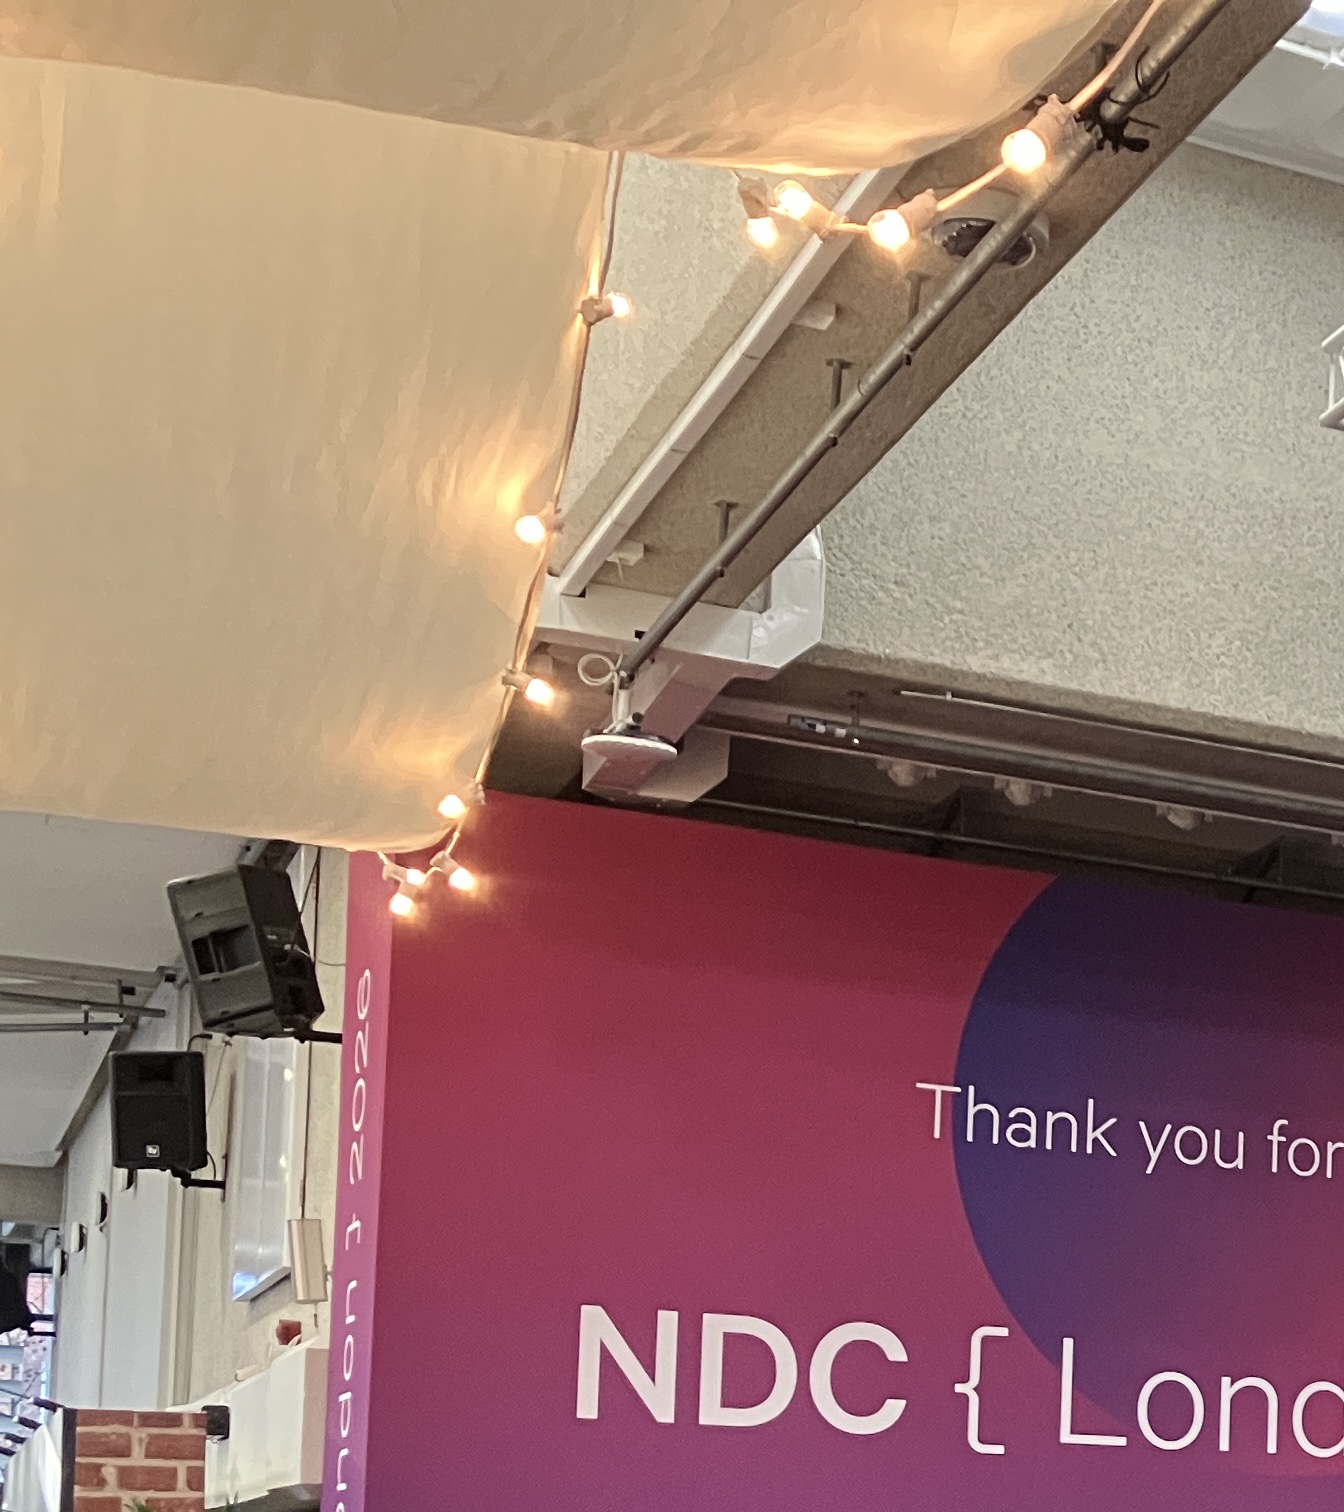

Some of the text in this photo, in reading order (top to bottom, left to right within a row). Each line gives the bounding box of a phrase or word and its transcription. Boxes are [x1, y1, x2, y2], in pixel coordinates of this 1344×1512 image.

[350, 969, 370, 1184] 2026
[916, 1083, 1117, 1156] Thank
[1139, 1121, 1243, 1174] you
[1267, 1120, 1344, 1178] for
[577, 1305, 908, 1434] NDC
[955, 1327, 1008, 1454] {
